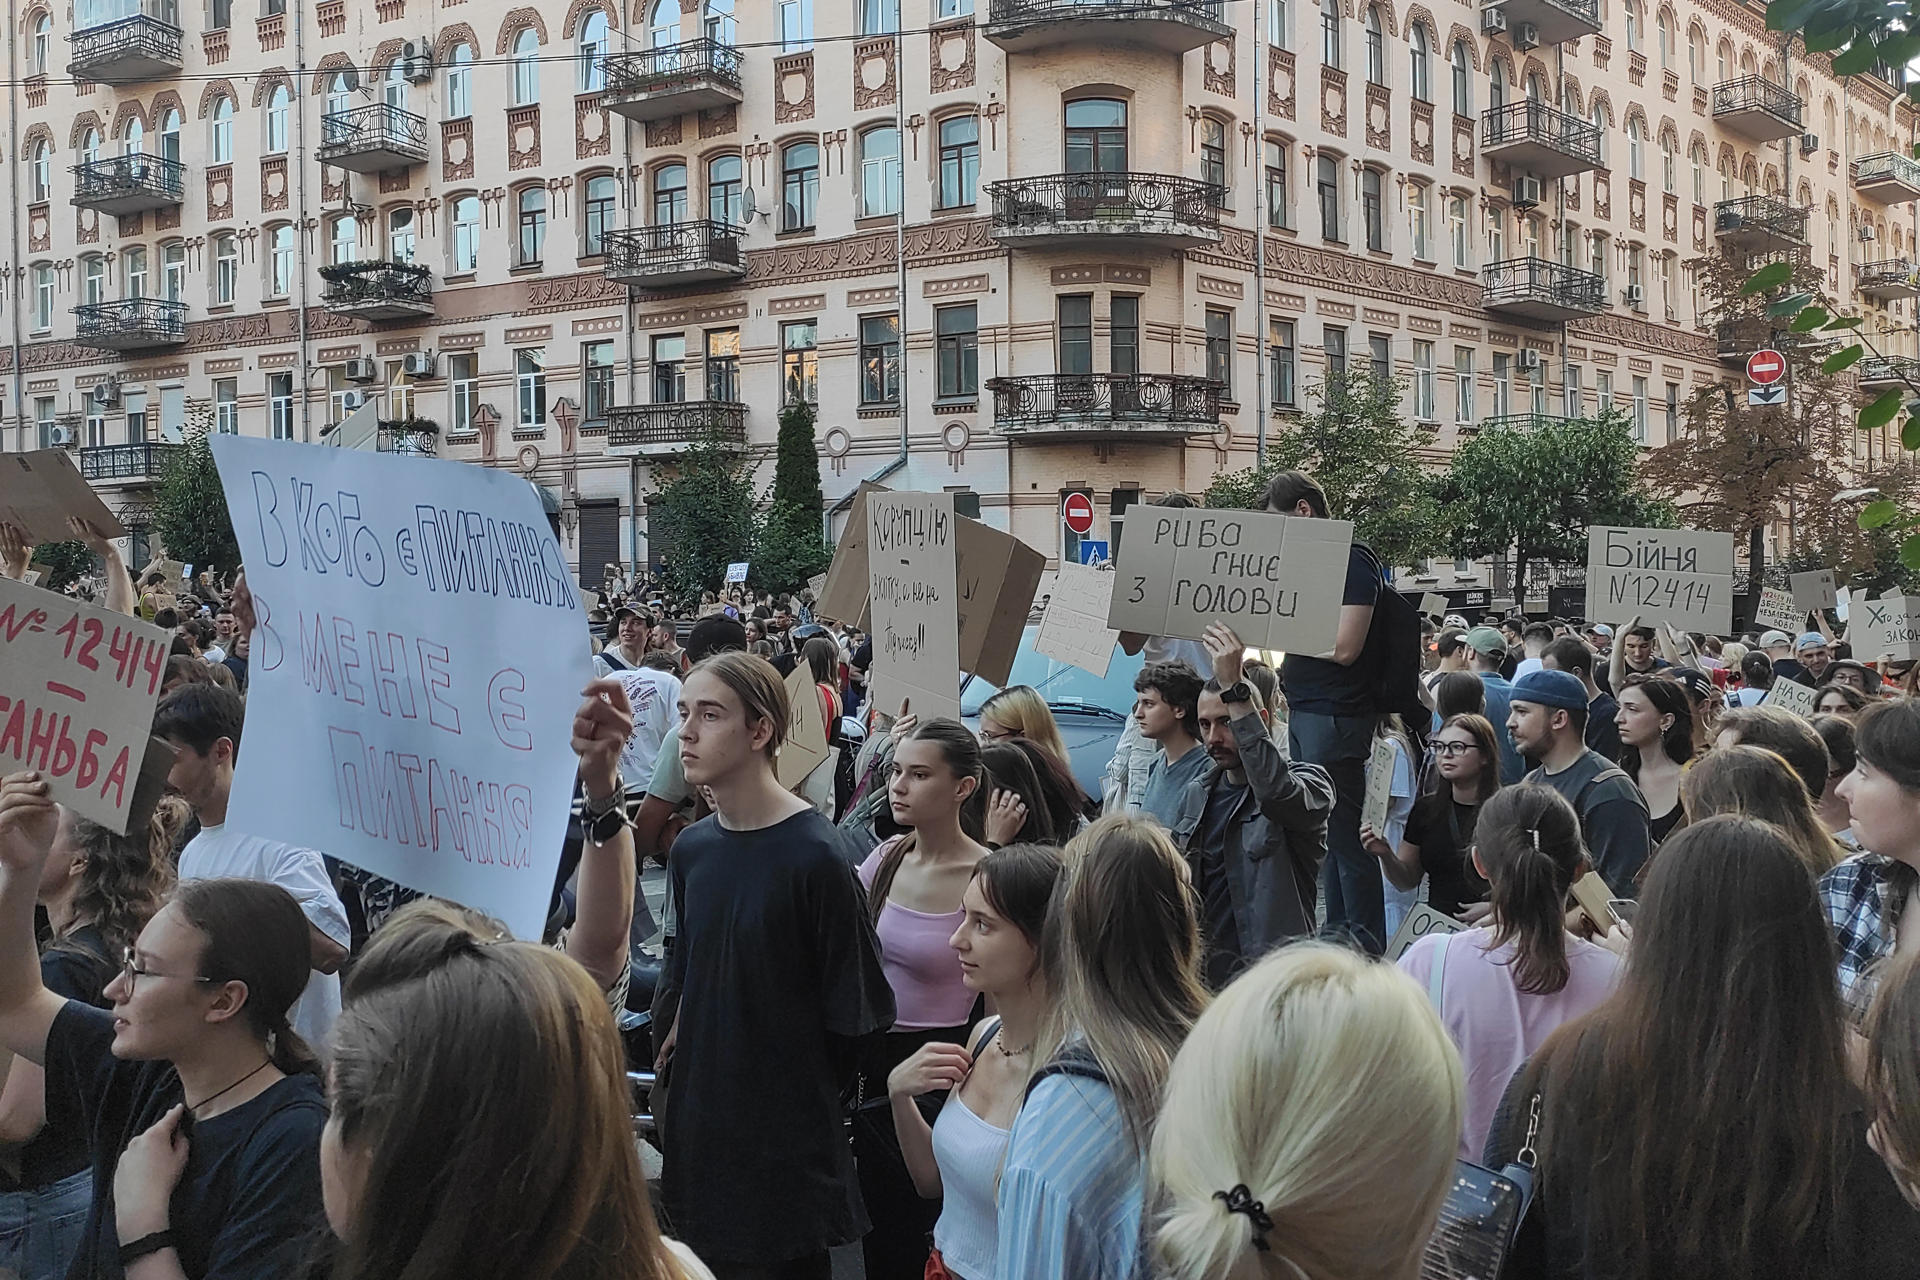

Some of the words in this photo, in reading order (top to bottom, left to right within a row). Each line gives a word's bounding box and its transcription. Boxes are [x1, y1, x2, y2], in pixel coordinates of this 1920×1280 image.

[251, 471, 288, 568] В
[290, 476, 386, 588] КОГО
[414, 504, 576, 610] ПИТАННЯ
[1173, 579, 1299, 619] ГОЛОВИ
[253, 594, 284, 672] В
[298, 610, 462, 735] МЕНЕ
[486, 667, 533, 752] Є
[327, 725, 533, 870] ПИТАННЯ
